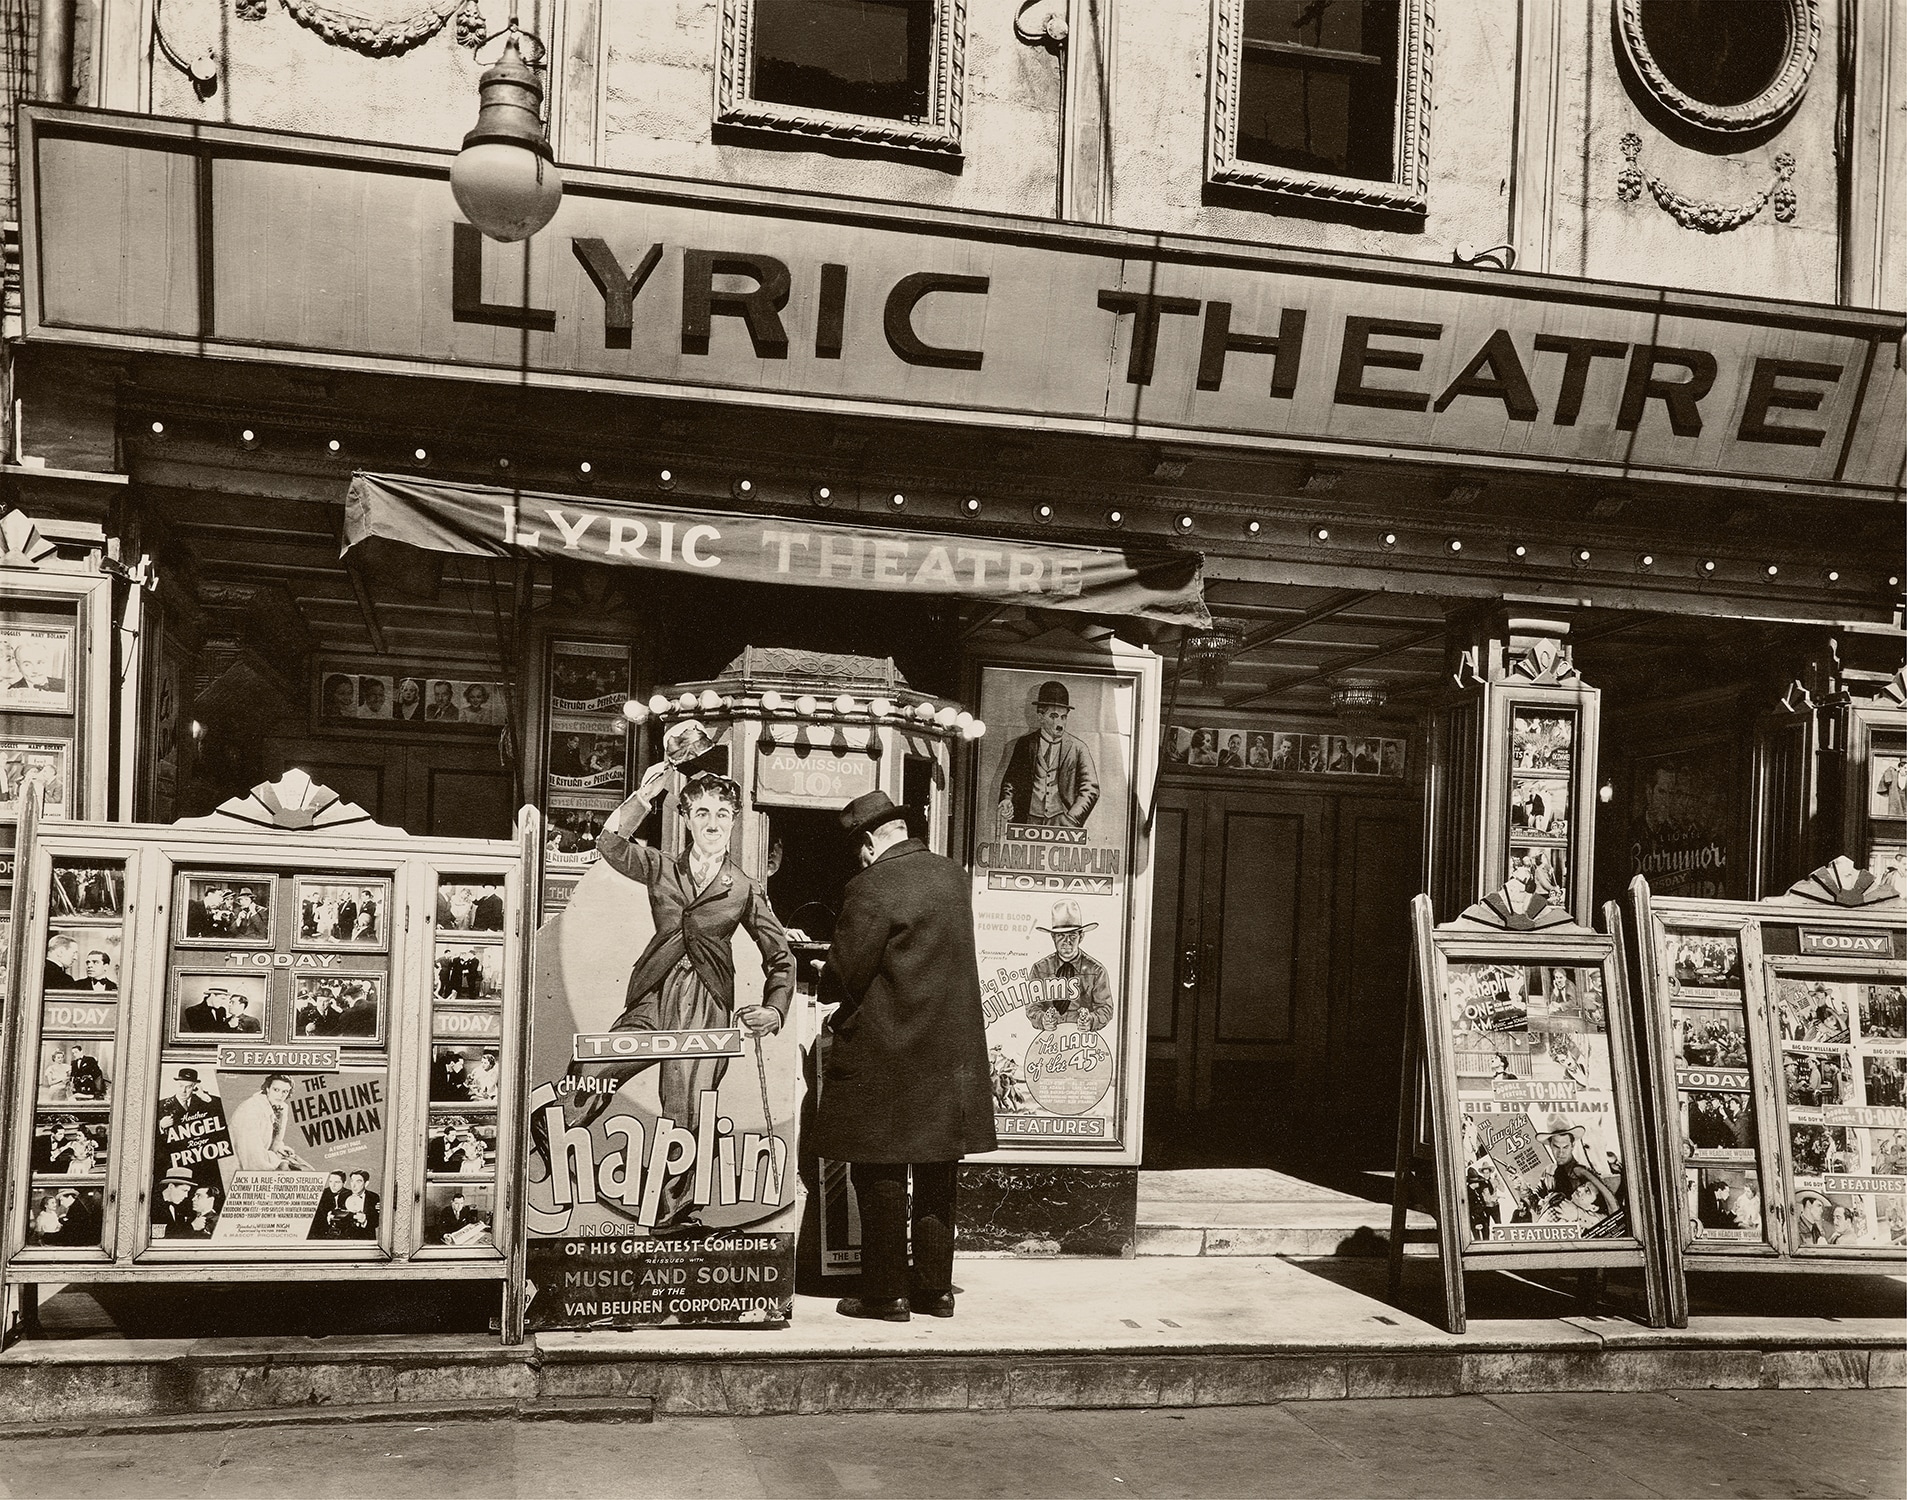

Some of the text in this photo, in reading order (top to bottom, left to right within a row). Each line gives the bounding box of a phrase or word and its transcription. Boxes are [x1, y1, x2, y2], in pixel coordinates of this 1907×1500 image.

[452, 221, 1843, 446] LYRIC THEATRE
[500, 504, 1083, 596] LYRIC THEATRE
[771, 756, 864, 775] ADMISSION
[556, 776, 583, 788] RETURN
[792, 772, 842, 797] 10¢
[1010, 827, 1084, 842] TODAY
[976, 842, 1121, 874] CHARLIE CHAPLIN
[994, 874, 1108, 892] TO-DAY
[978, 912, 1032, 921] WHERE BLOOD
[978, 923, 1009, 931] FLOWED
[1807, 934, 1883, 950] TODAY
[230, 952, 336, 968] TODAY
[47, 1007, 110, 1025] TODAY
[1465, 1001, 1495, 1020] ONE
[437, 1014, 494, 1033] TODAY
[584, 1032, 734, 1055] TO-DAY
[1060, 1033, 1098, 1052] LAW
[225, 1051, 333, 1066] 2 FEATURES
[302, 1075, 327, 1092] THE
[557, 1075, 618, 1095] CHARLIE
[1676, 1072, 1750, 1088] TODAY
[290, 1080, 383, 1123] HEADLINE
[1465, 1102, 1609, 1113] BIG BOY WILLIAMS
[181, 1111, 208, 1122] Heather
[166, 1116, 226, 1144] ANGEL
[300, 1107, 381, 1148] WOMAN
[1005, 1119, 1100, 1134] FEATURES
[187, 1138, 210, 1149] Roger
[170, 1140, 232, 1168] PRYOR
[526, 1081, 788, 1235] Chaplin
[234, 1177, 249, 1185] JACK
[1828, 1178, 1902, 1192] 2 FEATURES
[228, 1192, 242, 1200] JACK
[580, 1221, 636, 1237] IN ONE
[1497, 1227, 1575, 1241] 2 FEATURES
[565, 1236, 778, 1256] OF HIS GREATEST COMEDIES
[833, 1252, 849, 1260] THE
[565, 1266, 779, 1288] MUSIC AND SOUND
[652, 1287, 686, 1297] BY THE
[565, 1296, 779, 1317] VAN BEUREN CORPORATION
